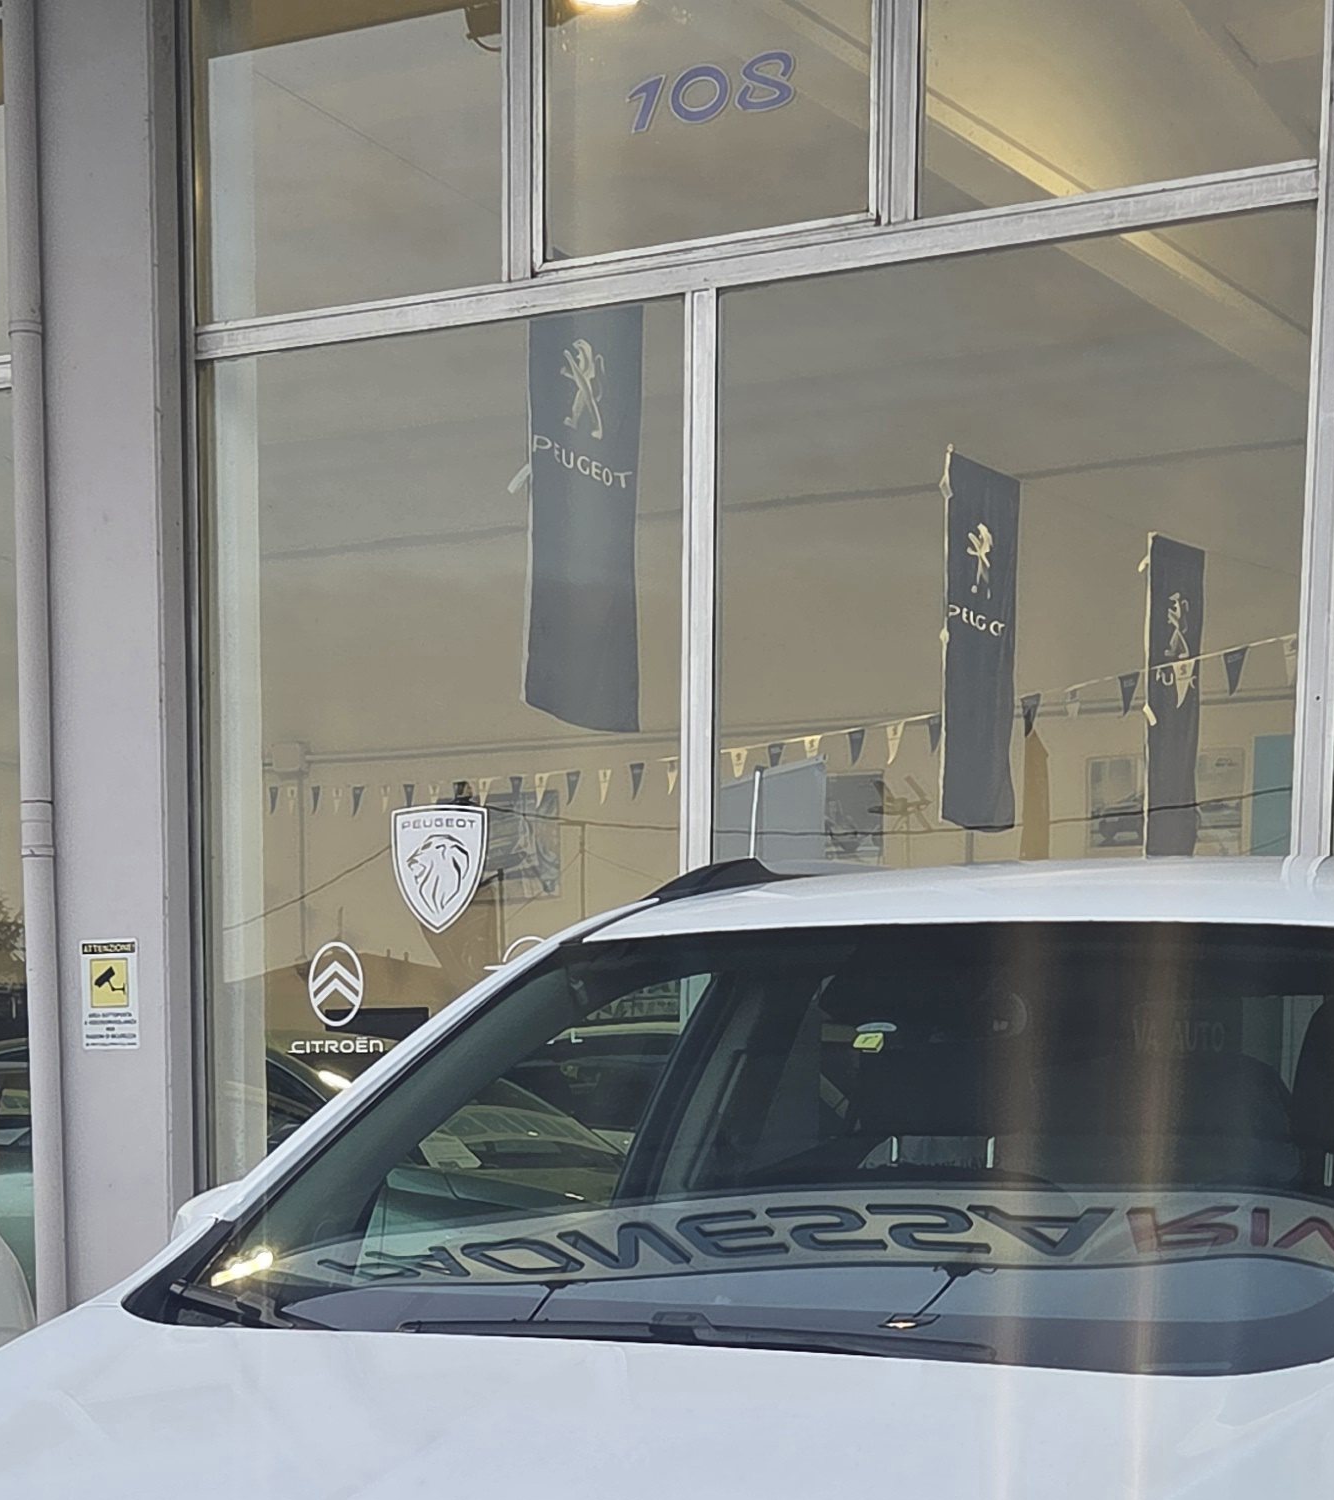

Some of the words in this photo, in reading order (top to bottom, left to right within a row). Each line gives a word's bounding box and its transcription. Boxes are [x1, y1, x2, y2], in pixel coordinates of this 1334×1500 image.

[625, 50, 795, 134] 108
[532, 434, 633, 489] PEUGEOT
[401, 817, 478, 830] PEUGEOT
